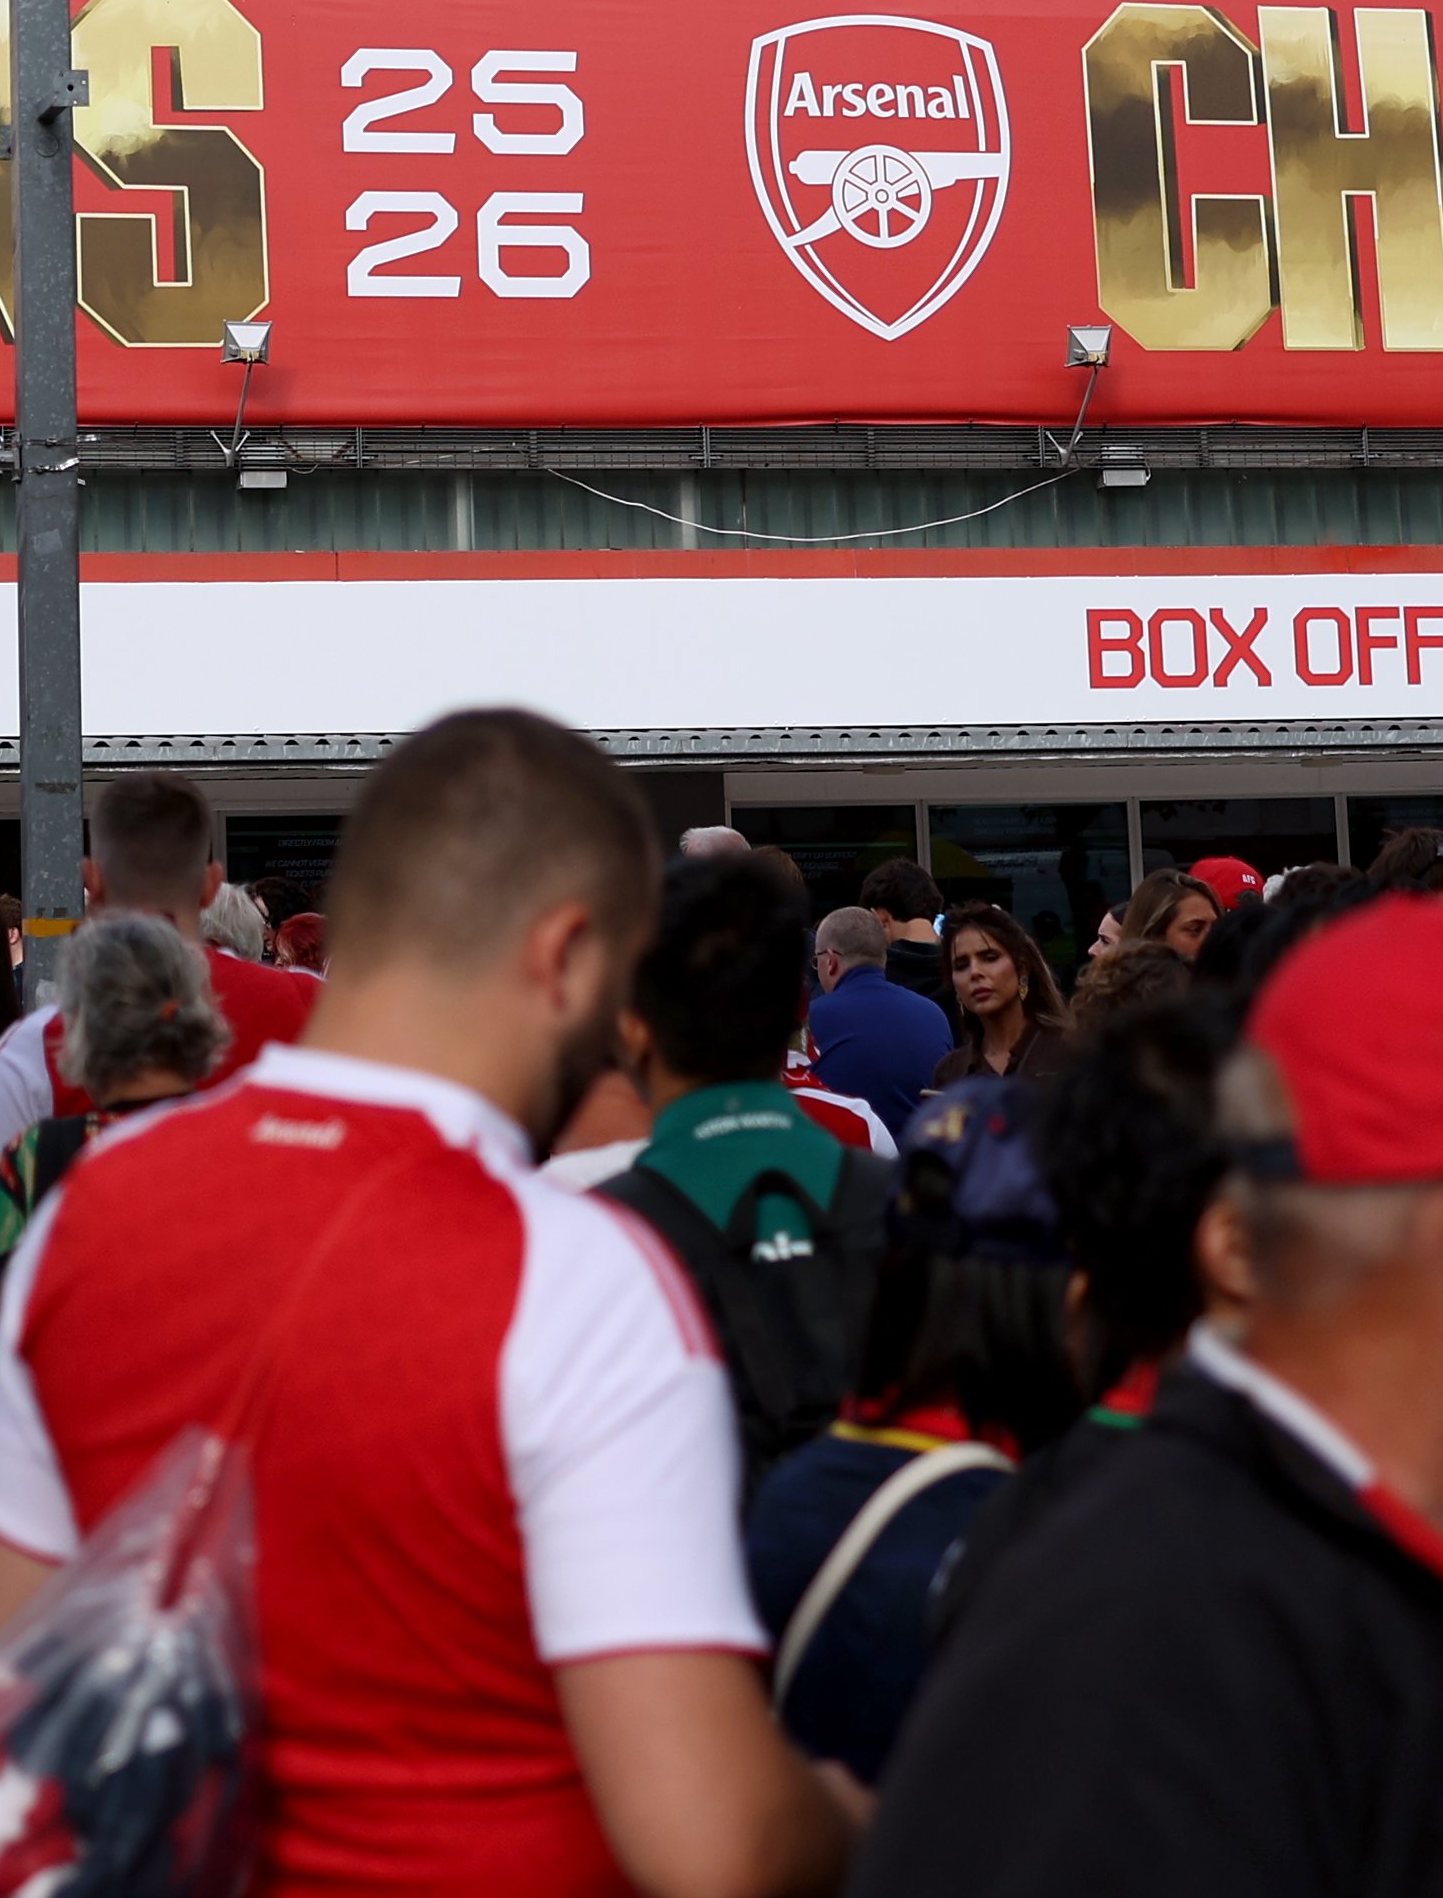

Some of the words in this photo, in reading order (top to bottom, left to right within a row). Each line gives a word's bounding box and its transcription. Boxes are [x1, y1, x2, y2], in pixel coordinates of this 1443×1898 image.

[339, 47, 586, 156] 25
[783, 71, 971, 121] Arsenal
[346, 190, 592, 299] 26
[1085, 606, 1272, 689] BOX
